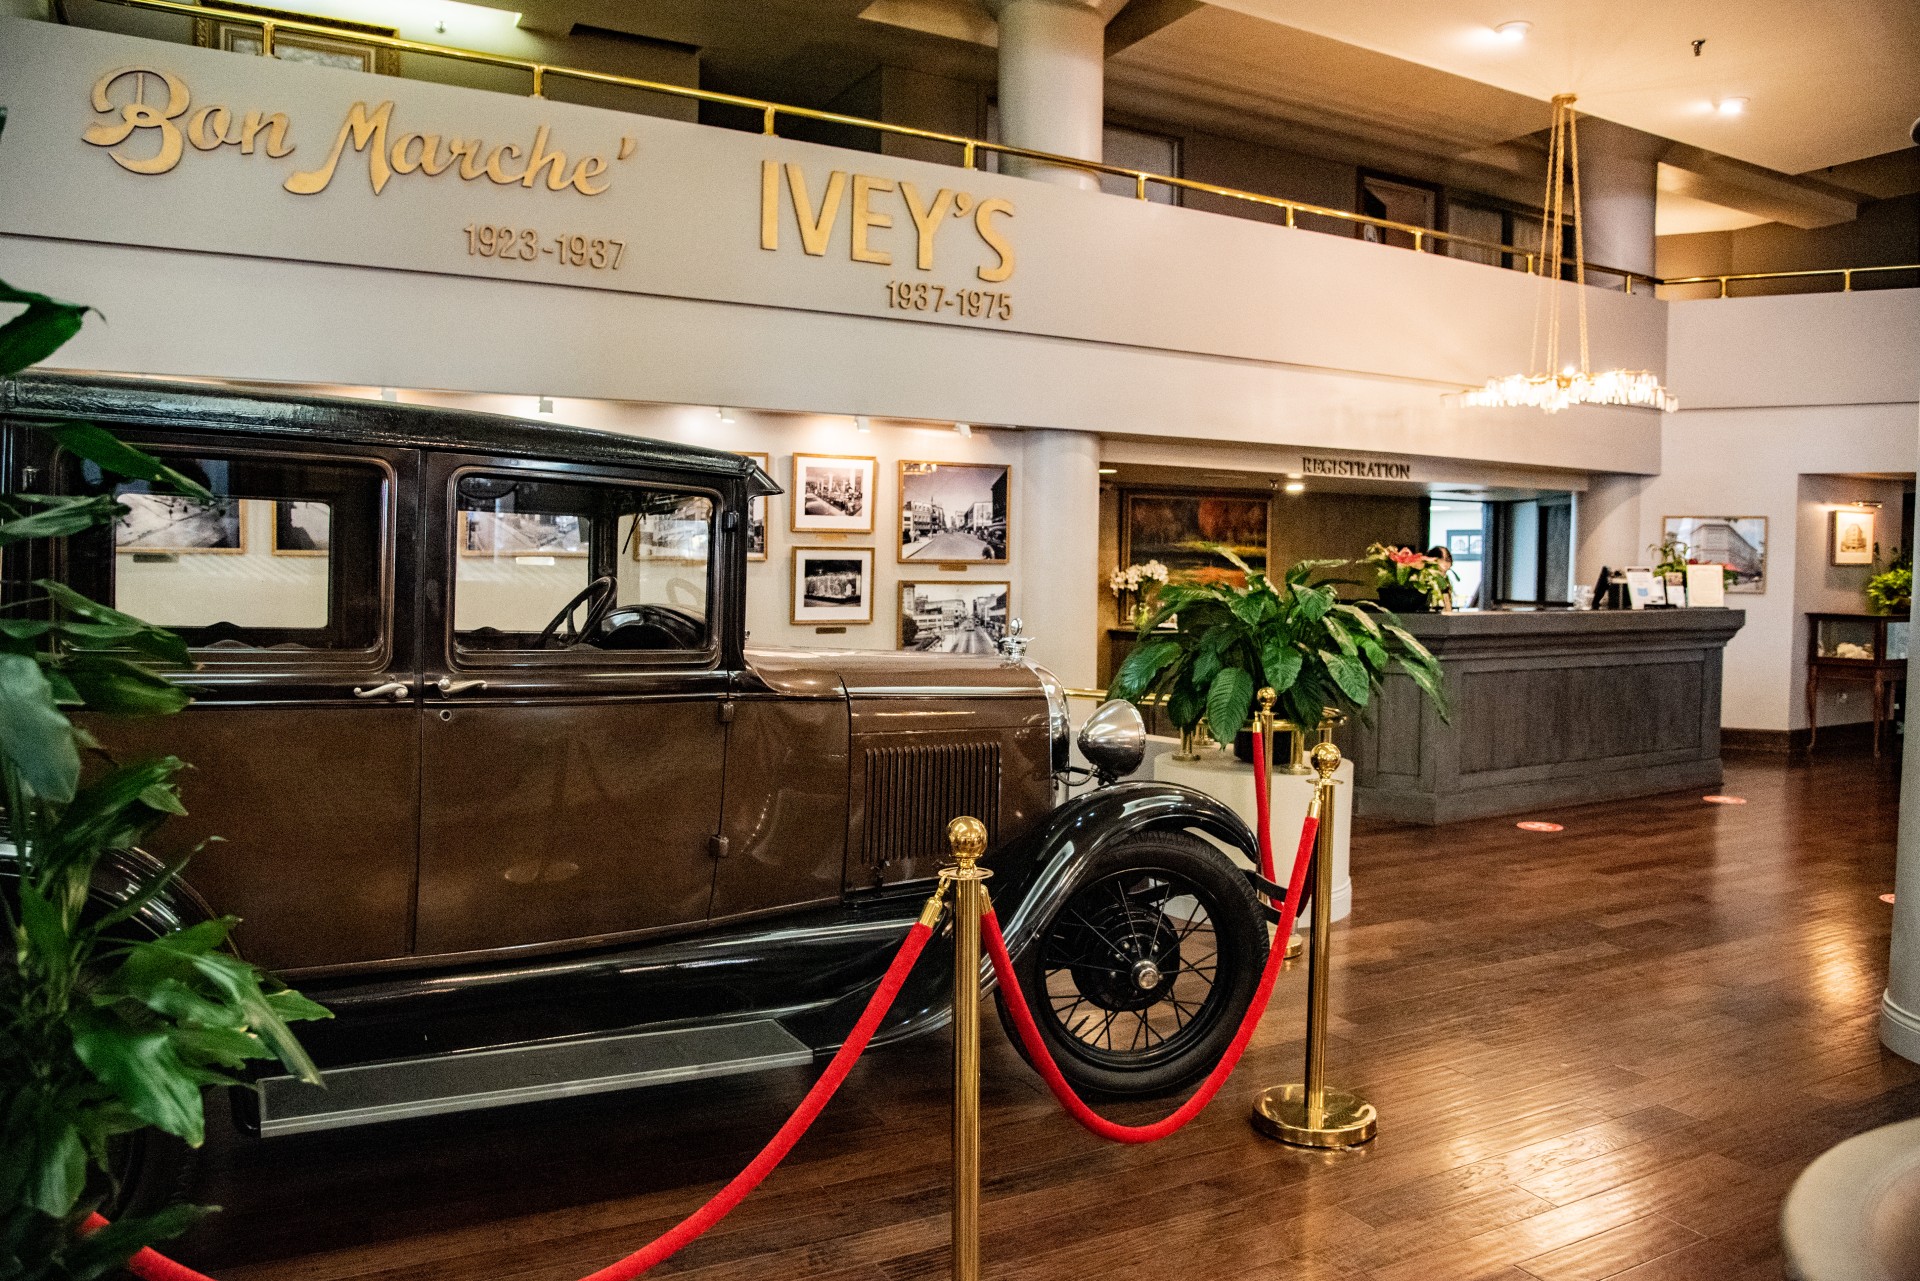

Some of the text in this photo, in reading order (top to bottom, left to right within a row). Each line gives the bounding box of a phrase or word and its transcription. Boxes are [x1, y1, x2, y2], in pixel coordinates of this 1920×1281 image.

[82, 64, 295, 175] Bon
[464, 222, 628, 270] 1923-1937
[886, 279, 1014, 321] 1937-1975
[1302, 457, 1410, 480] REGISTRATION
